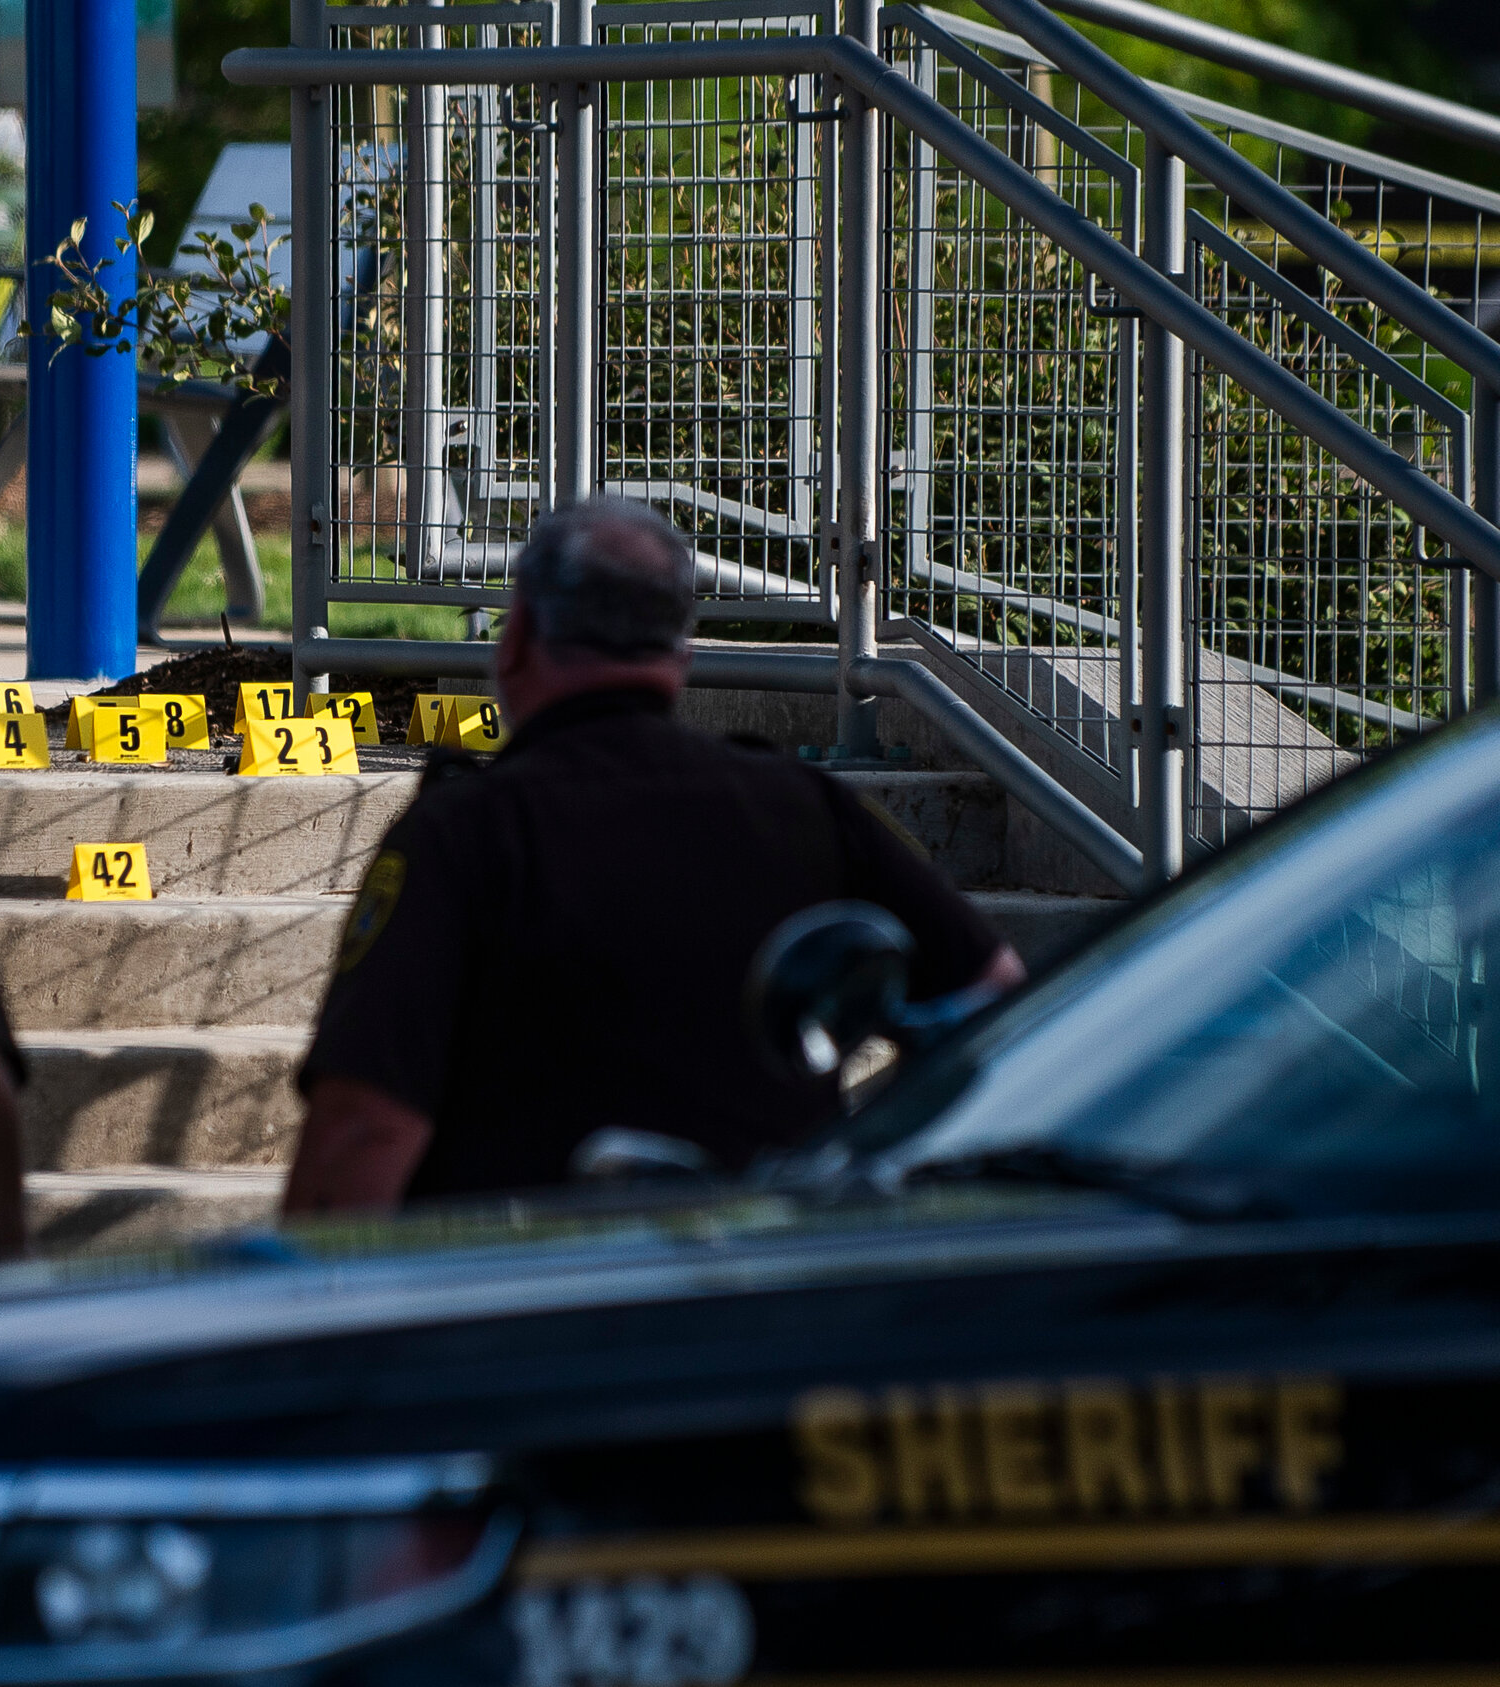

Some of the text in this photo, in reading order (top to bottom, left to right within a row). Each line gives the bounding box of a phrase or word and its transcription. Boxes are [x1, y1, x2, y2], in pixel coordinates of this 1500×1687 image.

[164, 701, 185, 737] 8
[257, 688, 293, 720] 17
[325, 698, 366, 733] 12
[479, 702, 499, 739] 9
[5, 720, 27, 756] 4
[119, 714, 141, 752] 5
[274, 727, 298, 765] 2
[315, 726, 332, 764] 3
[92, 851, 137, 888] 42
[790, 1374, 1343, 1523] SHERIFF
